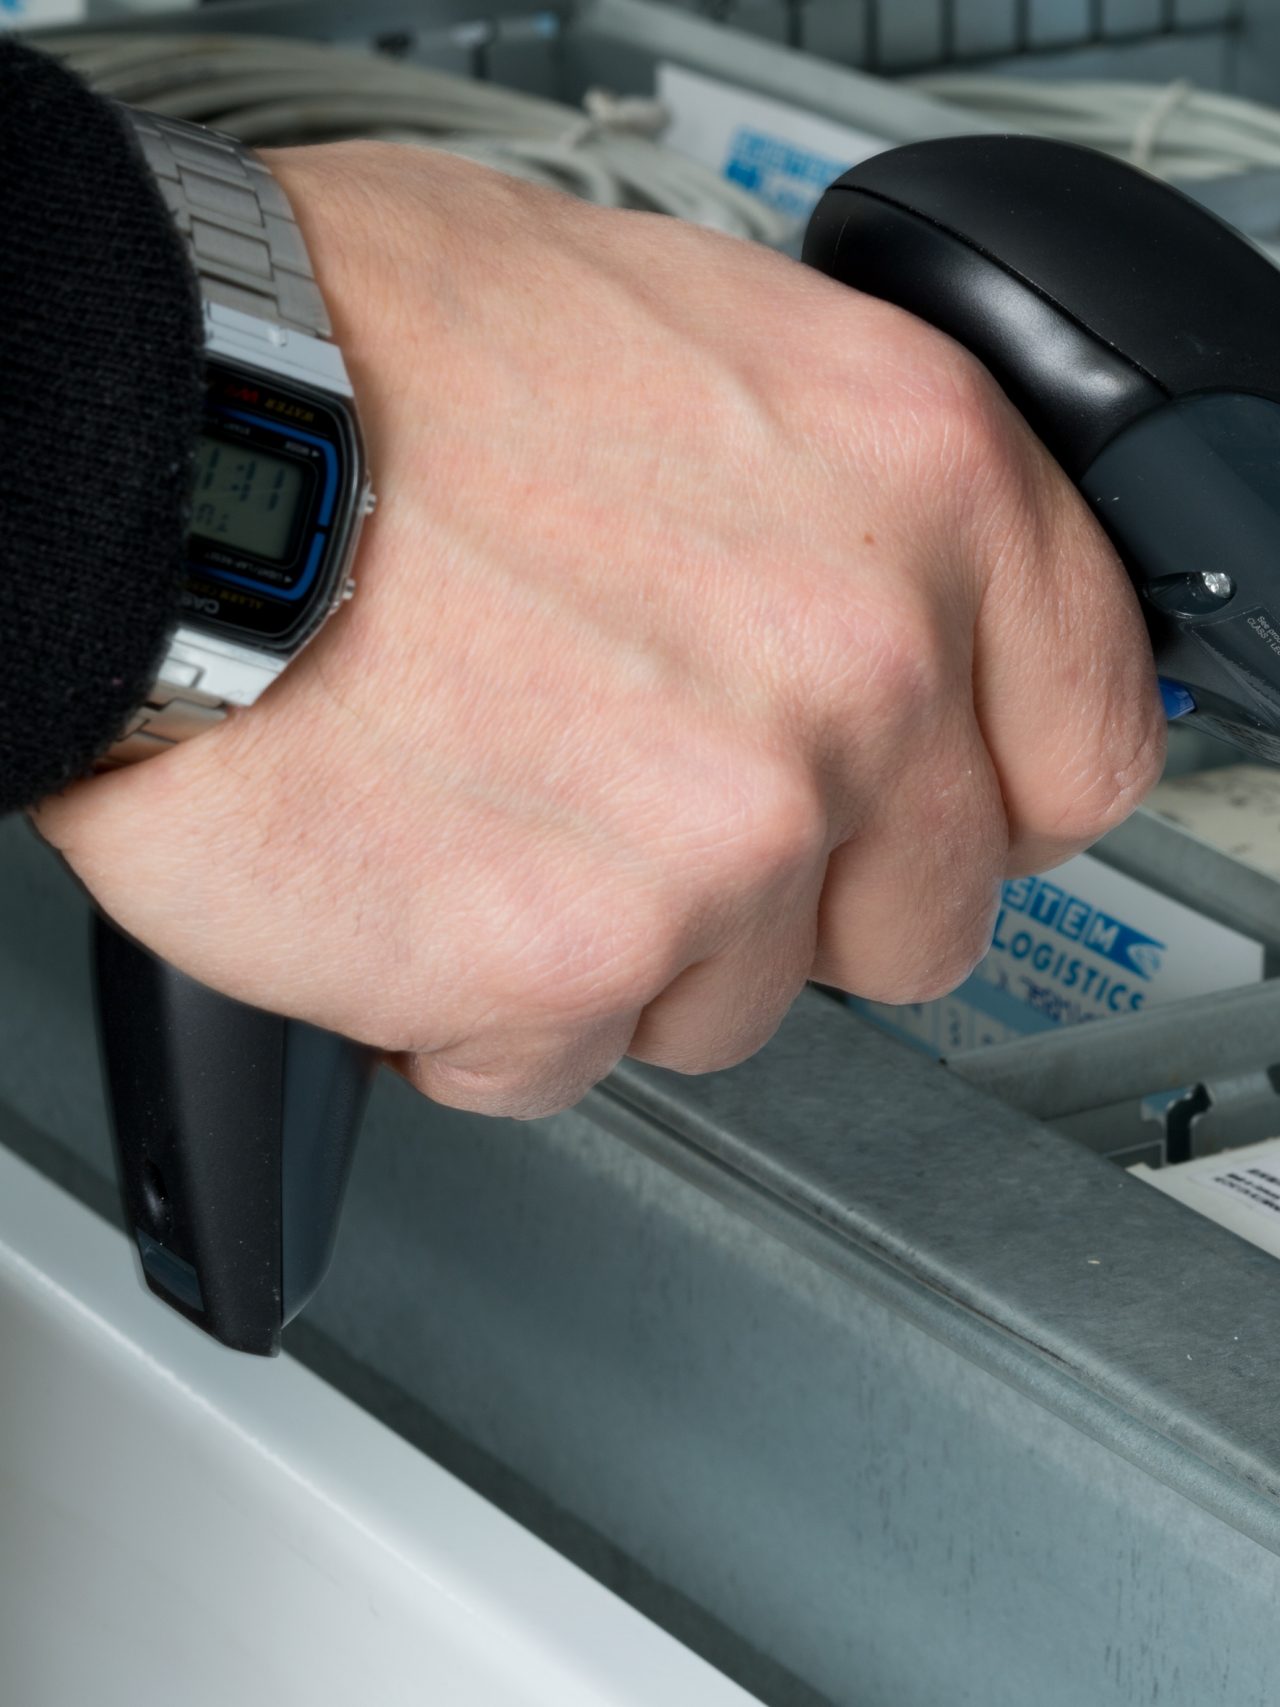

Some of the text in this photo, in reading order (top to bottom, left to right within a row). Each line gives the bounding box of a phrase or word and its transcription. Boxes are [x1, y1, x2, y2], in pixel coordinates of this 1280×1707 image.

[1246, 616, 1268, 639] CLASS
[1256, 615, 1271, 631] See
[1003, 876, 1121, 953] STEM
[992, 910, 1146, 1012] LOGISTICS
